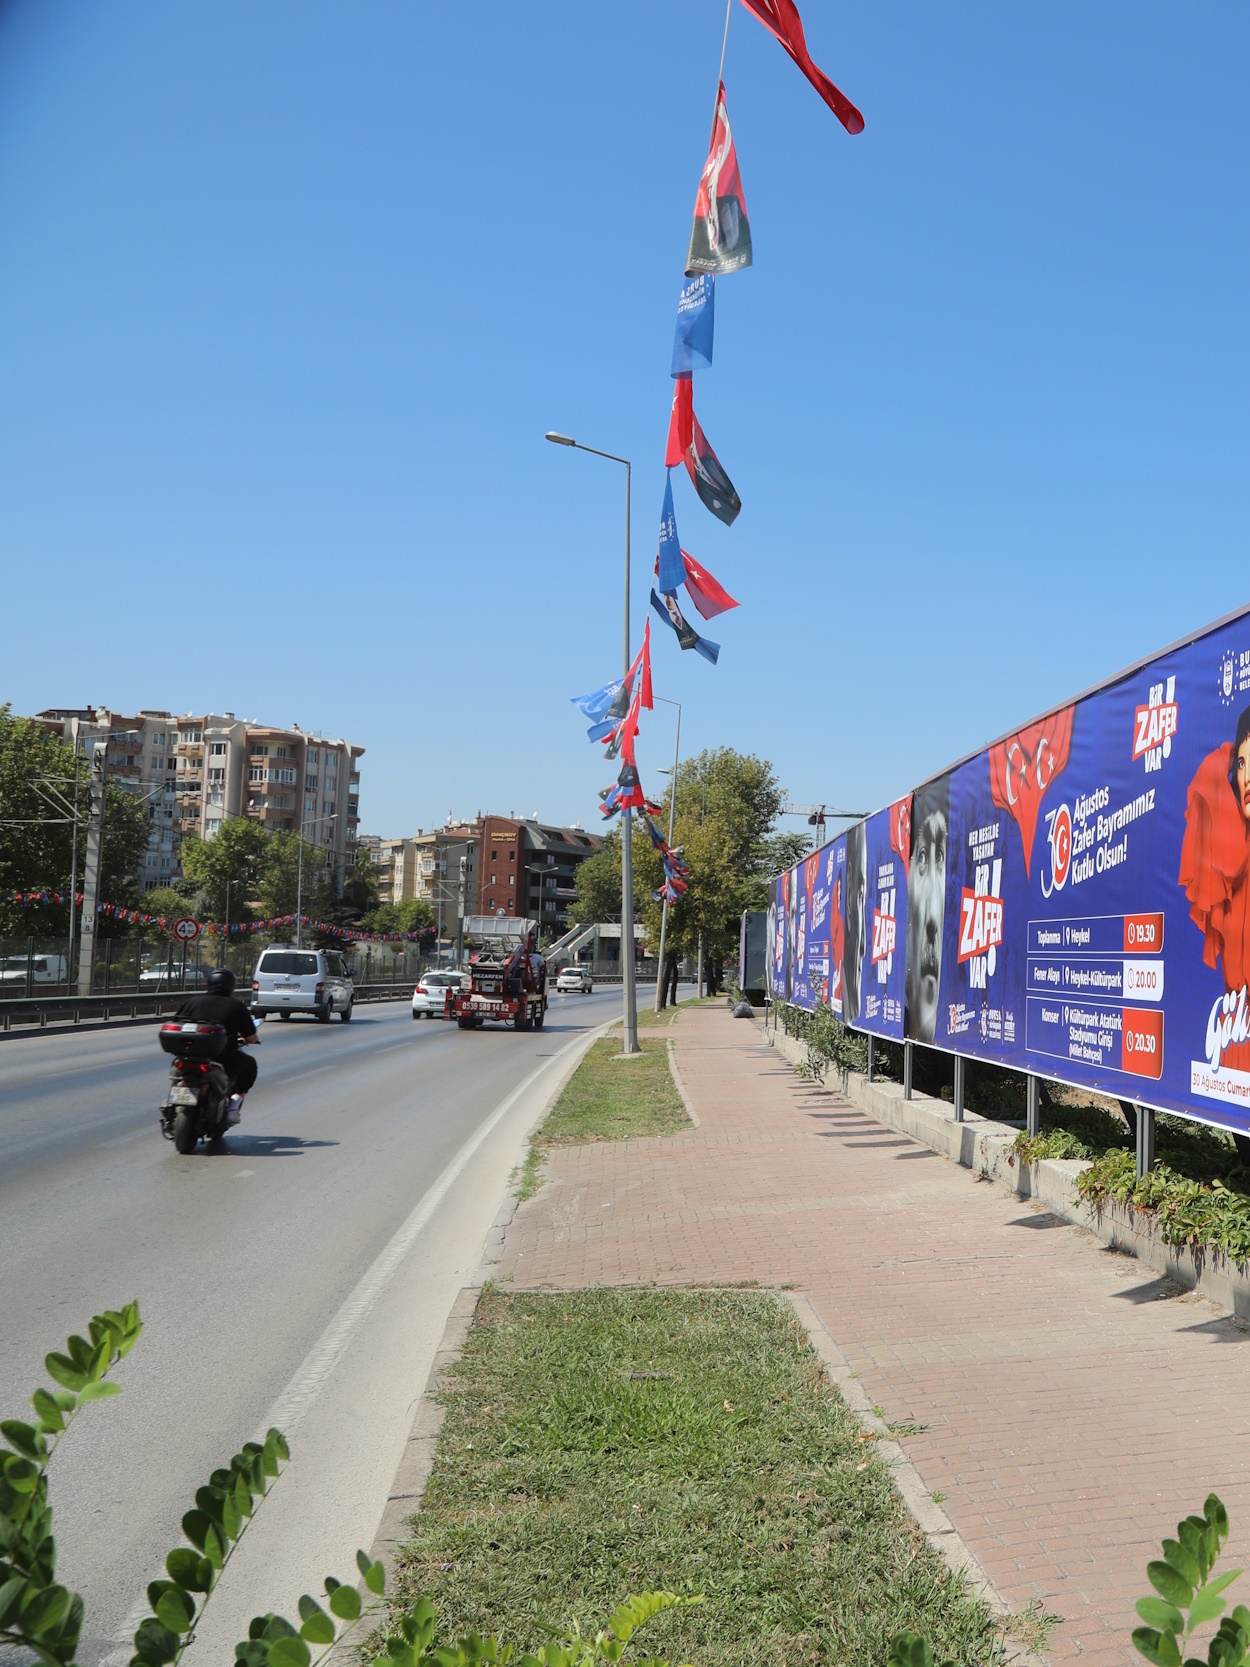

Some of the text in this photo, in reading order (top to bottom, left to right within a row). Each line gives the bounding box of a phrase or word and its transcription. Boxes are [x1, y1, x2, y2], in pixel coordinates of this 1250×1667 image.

[1134, 706, 1177, 755] ZAFER
[1072, 788, 1155, 856] Zafer Bayramımız
[1073, 786, 1109, 827] Ağustos
[1071, 834, 1128, 886] Kutlu Olsun!
[872, 915, 896, 959] ZAFER
[960, 897, 1003, 956] ZAFER
[1037, 923, 1155, 947] Toplanma Heykel 19.30
[1034, 967, 1047, 981] Fener
[1070, 970, 1122, 990] Heykel-Kültürpark
[1136, 971, 1156, 989] 20.00
[462, 1002, 478, 1010] 0539
[492, 1003, 500, 1011] 14
[1042, 1008, 1156, 1053] Konser Kültürpark Atatürk 20.30
[1069, 1027, 1113, 1052] Stadyumu Girişi
[1193, 1073, 1200, 1086] 30
[1201, 1075, 1226, 1092] Ağustos
